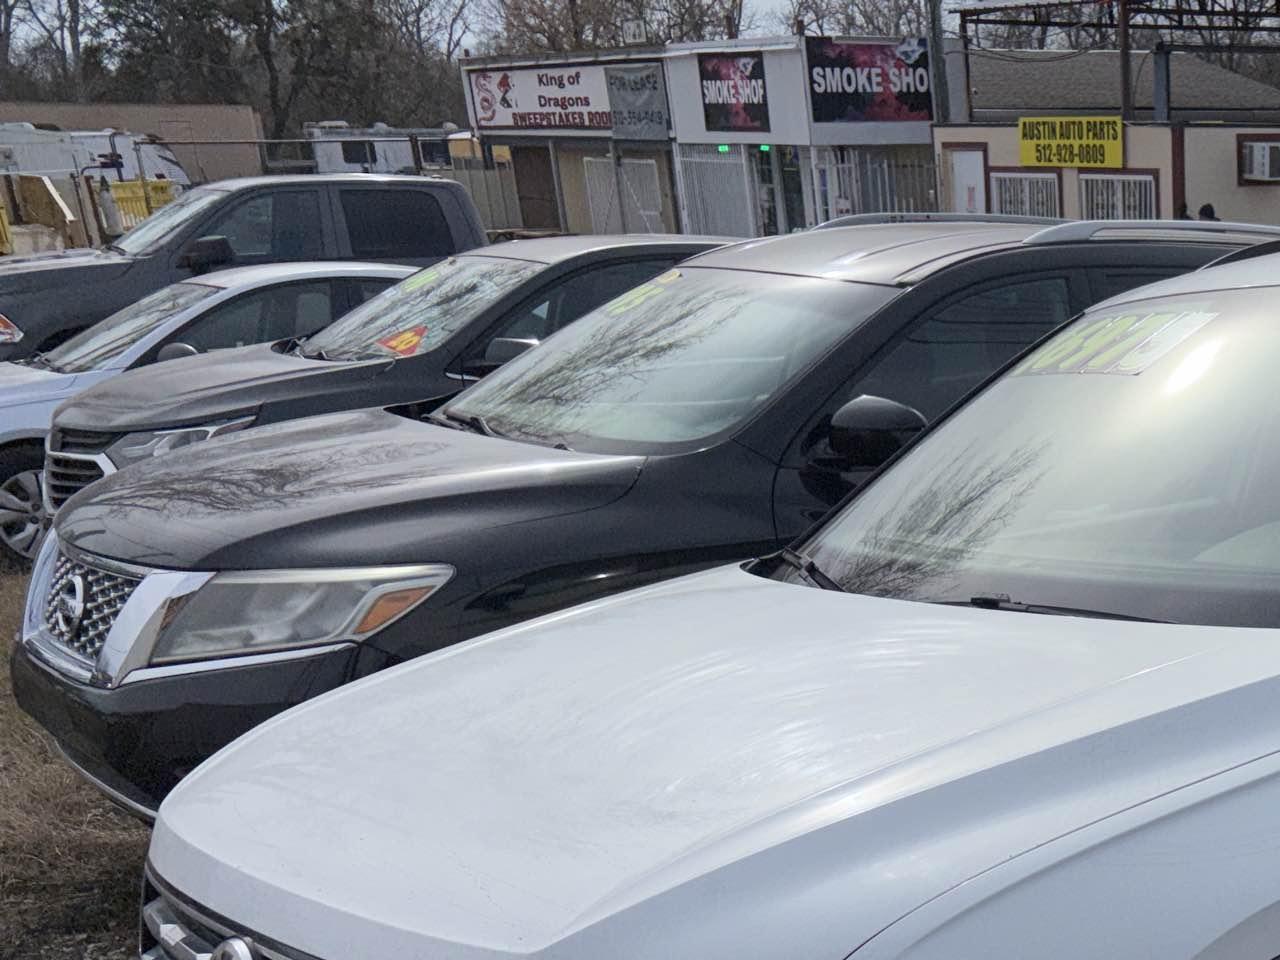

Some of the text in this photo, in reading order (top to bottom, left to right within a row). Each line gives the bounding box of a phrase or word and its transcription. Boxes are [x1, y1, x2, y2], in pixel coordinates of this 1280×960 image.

[537, 71, 581, 88] King of
[812, 66, 930, 93] SMOKE SHO
[702, 79, 737, 104] SMOKE
[537, 94, 590, 109] Dragons
[511, 111, 585, 127] SWEEPSTAKES
[1021, 120, 1119, 140] AUSTIN AUTO PARTS
